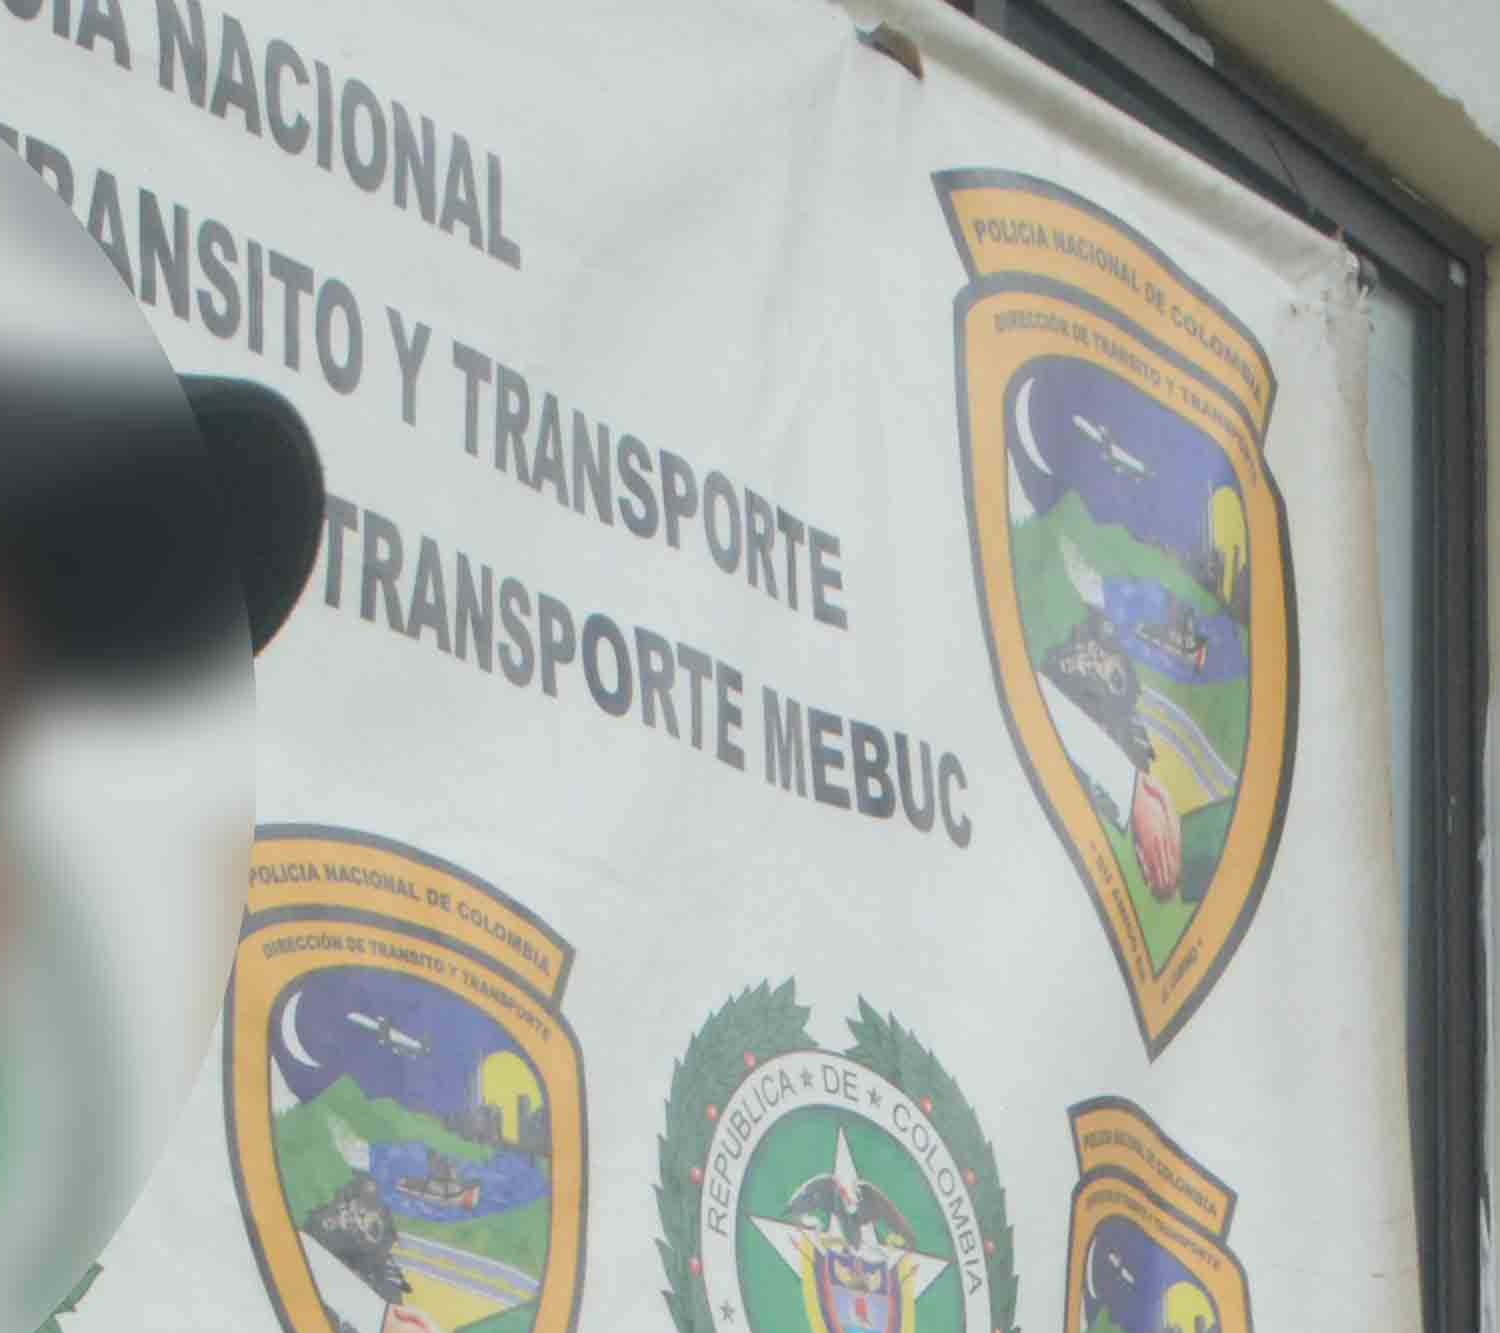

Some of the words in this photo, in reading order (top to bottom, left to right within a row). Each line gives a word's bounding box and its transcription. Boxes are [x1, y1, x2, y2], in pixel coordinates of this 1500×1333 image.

[155, 0, 521, 270] NACIONAL
[971, 217, 1050, 251] POLICIA
[1052, 230, 1141, 294] NACIONAL
[1144, 280, 1168, 318] DE
[1170, 304, 1264, 402] COLOMBIA
[386, 304, 433, 428] Y
[452, 338, 849, 633] TRANSPORTE
[321, 492, 746, 773] TRANSPORTE
[761, 684, 973, 850] MEBUC
[324, 863, 421, 902] NACIONAL
[426, 887, 453, 914] DE
[456, 901, 553, 978] COLOMBIA
[706, 1068, 797, 1238] REPUBLICA
[820, 1064, 859, 1103] DE
[891, 1103, 984, 1296] COLOMBIA
